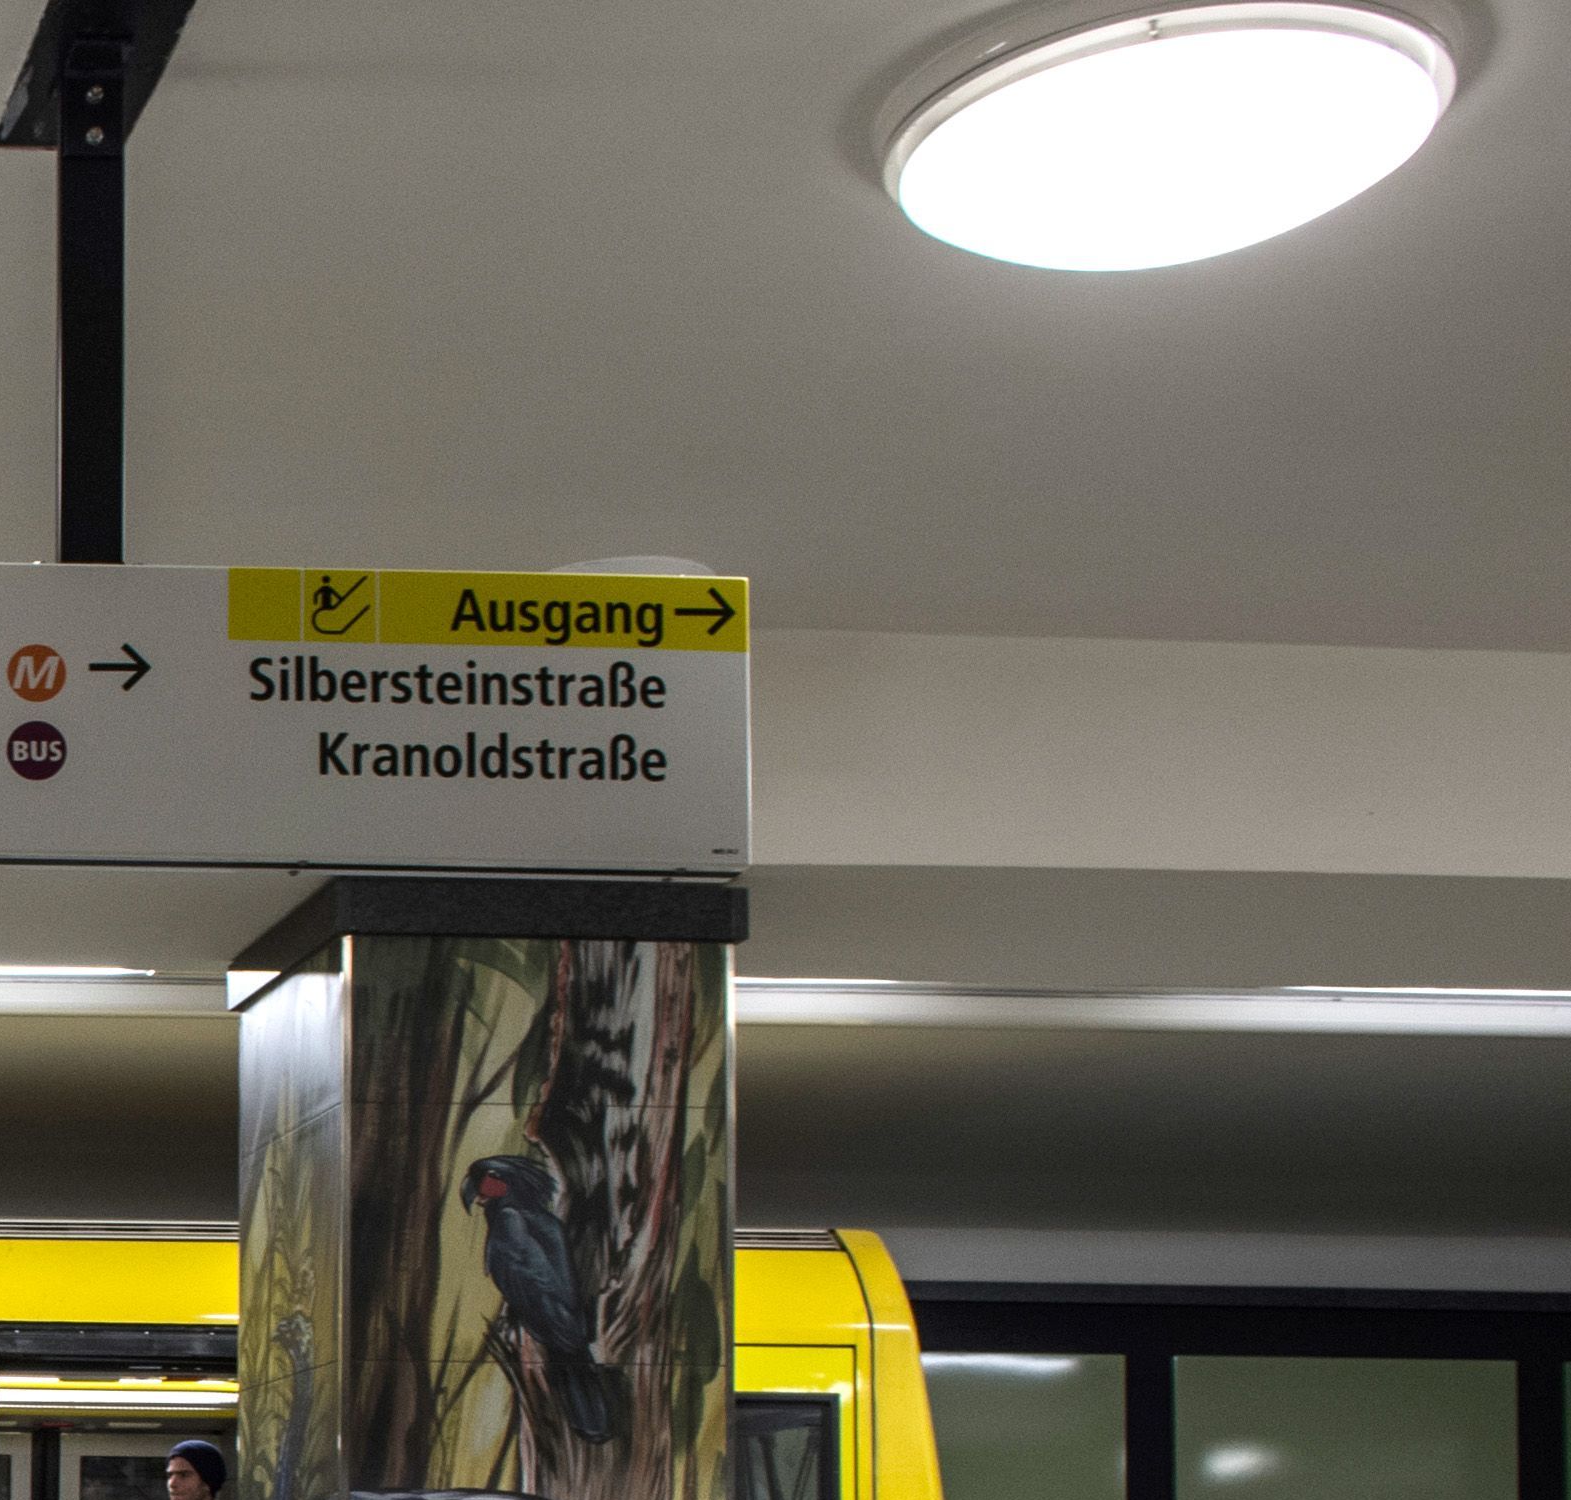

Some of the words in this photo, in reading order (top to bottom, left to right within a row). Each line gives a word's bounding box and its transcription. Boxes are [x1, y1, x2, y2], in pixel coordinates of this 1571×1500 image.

[450, 588, 664, 648] Ausgang
[12, 655, 61, 690] M
[248, 655, 667, 709] Silbersteinstraße
[11, 739, 64, 762] BUS
[317, 731, 668, 782] Kranoldstraße
